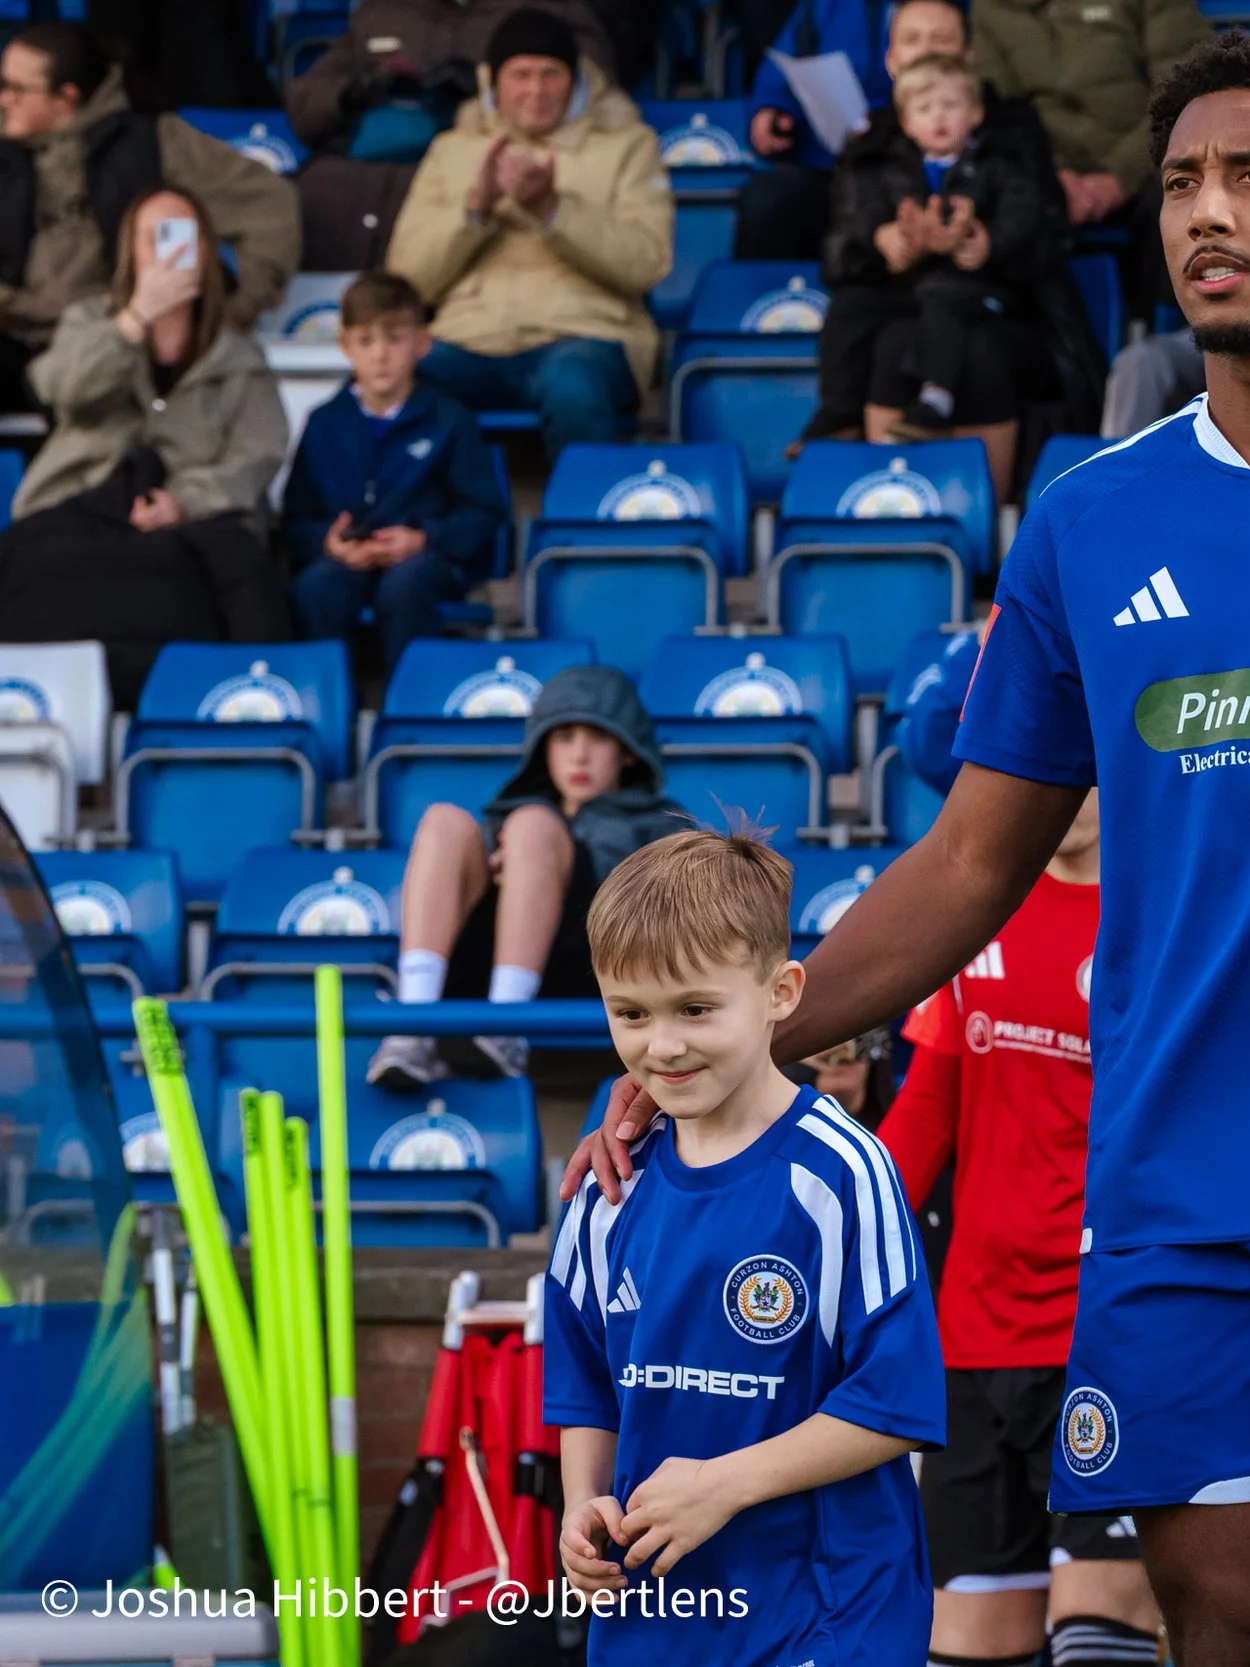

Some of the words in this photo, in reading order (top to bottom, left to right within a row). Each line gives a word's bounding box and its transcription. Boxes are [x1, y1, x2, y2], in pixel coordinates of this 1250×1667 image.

[731, 1261, 767, 1288] CURZON
[771, 1262, 803, 1295] ASHTON
[730, 1307, 775, 1338] FOOTBALL
[778, 1314, 800, 1335] CLUB
[1087, 1393, 1113, 1422] ASHTON
[1097, 1442, 1113, 1463] CLUB
